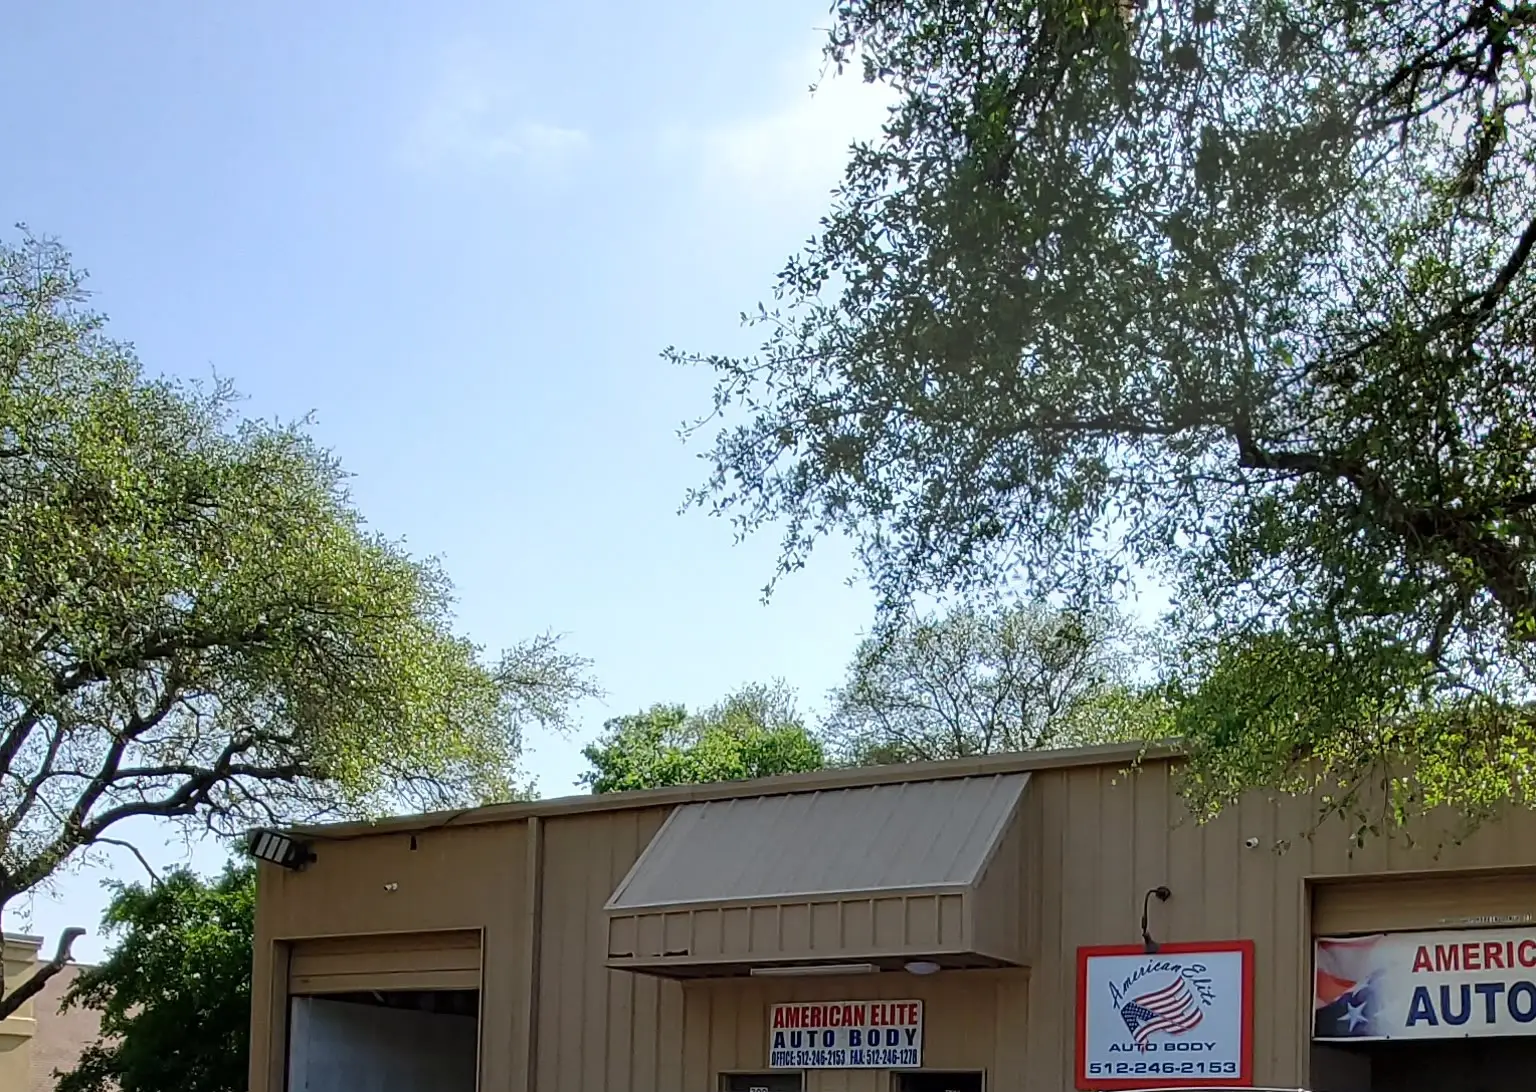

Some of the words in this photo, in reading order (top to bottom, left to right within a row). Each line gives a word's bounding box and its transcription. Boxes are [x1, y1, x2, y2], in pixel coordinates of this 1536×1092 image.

[1108, 959, 1182, 1011] American
[1181, 963, 1217, 1007] Elite
[773, 1005, 866, 1029] AMERICAN
[870, 1003, 918, 1026] ELITE
[773, 1029, 835, 1049] AUTO
[849, 1028, 917, 1047] BODY
[1108, 1042, 1158, 1053] AUTO
[1164, 1042, 1217, 1051] BODY
[796, 1050, 846, 1066] 512-246-2153
[1089, 1062, 1236, 1074] 512-246-2153
